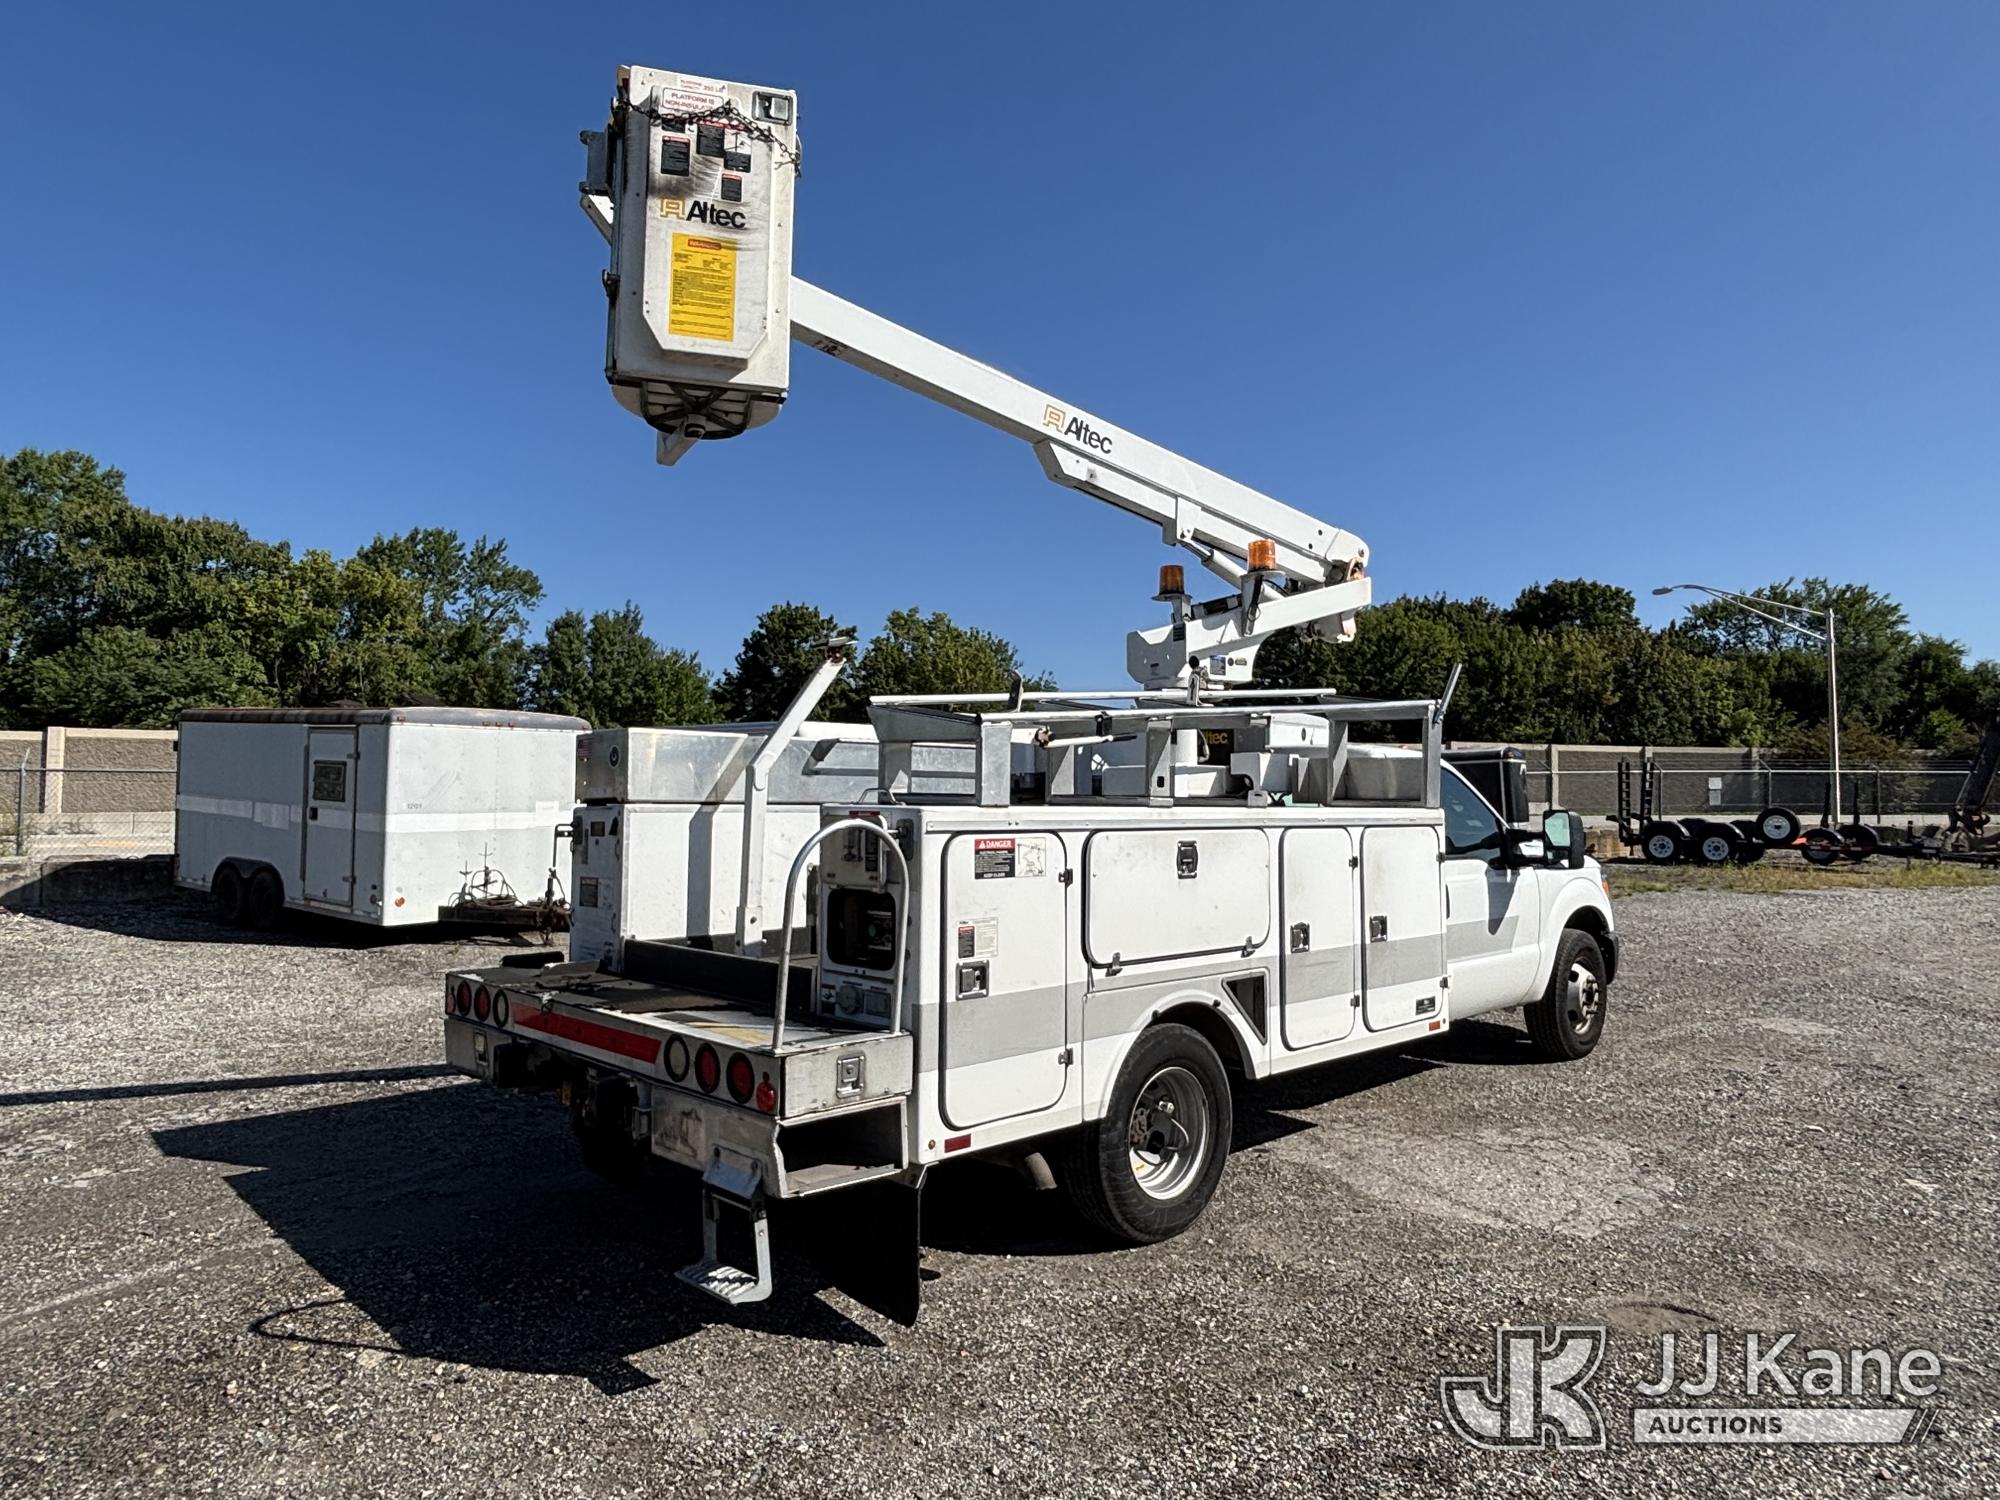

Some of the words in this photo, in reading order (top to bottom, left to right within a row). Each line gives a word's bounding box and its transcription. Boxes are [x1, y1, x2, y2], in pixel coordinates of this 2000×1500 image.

[671, 92, 708, 104] PLATFORM
[686, 200, 746, 229] Altec
[1064, 416, 1113, 454] Altec
[986, 840, 1012, 849] DANGER
